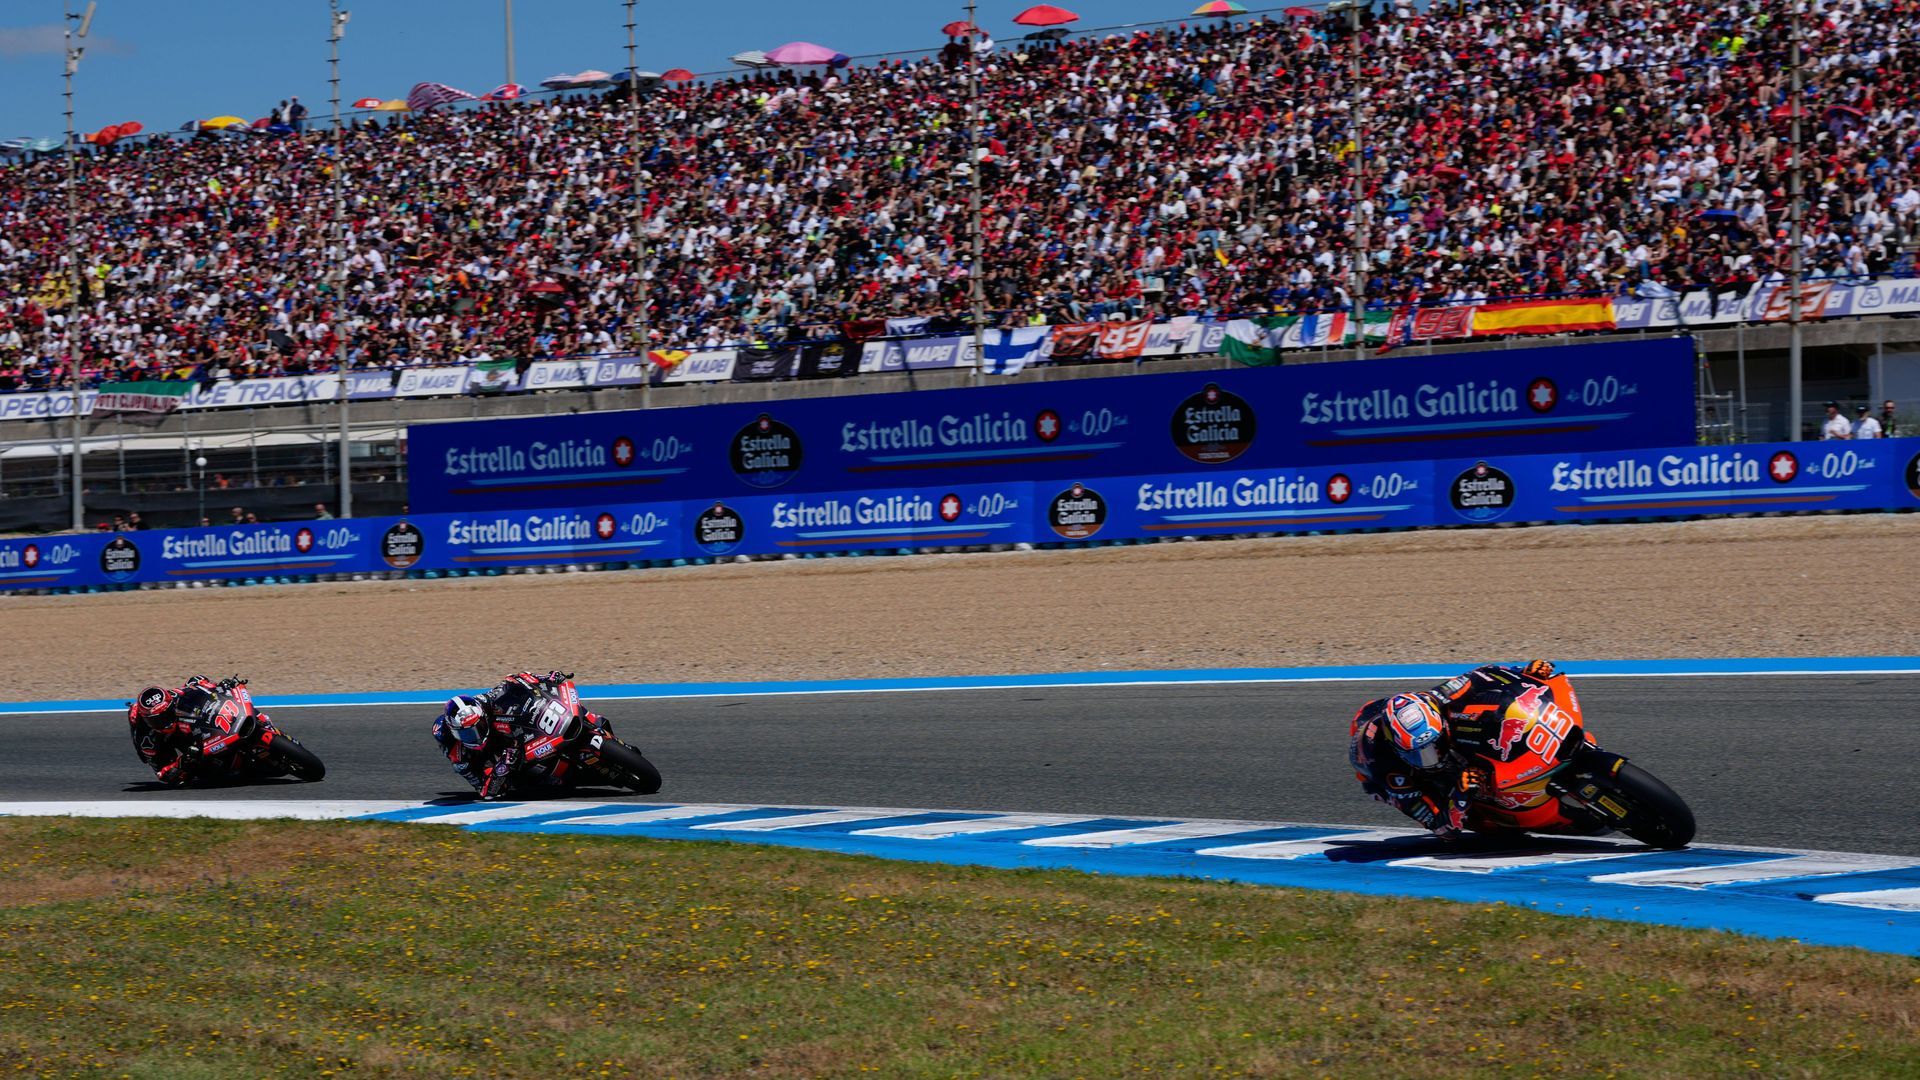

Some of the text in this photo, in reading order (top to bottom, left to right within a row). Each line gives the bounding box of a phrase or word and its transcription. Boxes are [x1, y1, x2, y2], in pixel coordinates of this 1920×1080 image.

[687, 359, 731, 374] MAPEI
[905, 345, 957, 362] MAPEI
[355, 377, 393, 393] MAPE
[420, 374, 461, 390] MAPEI
[1583, 375, 1618, 406] 0,0
[0, 394, 97, 417] PECOAT
[237, 380, 324, 403] TRACK
[1300, 380, 1519, 425] Estrella Galicia
[1082, 408, 1112, 436] 0,0
[1184, 406, 1241, 424] Estrella
[841, 412, 1028, 452] Estrella Galicia
[1187, 423, 1239, 443] Galicia
[445, 447, 525, 475] Estrella
[529, 439, 606, 470] Galicia
[652, 436, 679, 463] 0,0
[1550, 453, 1760, 492] Estrella Galicia
[1822, 450, 1858, 479] 0,0
[1136, 475, 1320, 511] Estrella Galicia
[1372, 473, 1402, 499] 0,0
[771, 495, 933, 529] Estrella Galicia
[978, 493, 1003, 517] 0,0
[448, 513, 591, 544] Estrella Galicia
[631, 512, 656, 535] 0,0
[162, 528, 291, 560] Estrella Galicia
[326, 527, 349, 550] 0,0
[538, 700, 567, 735] 81
[1526, 701, 1574, 764] 95
